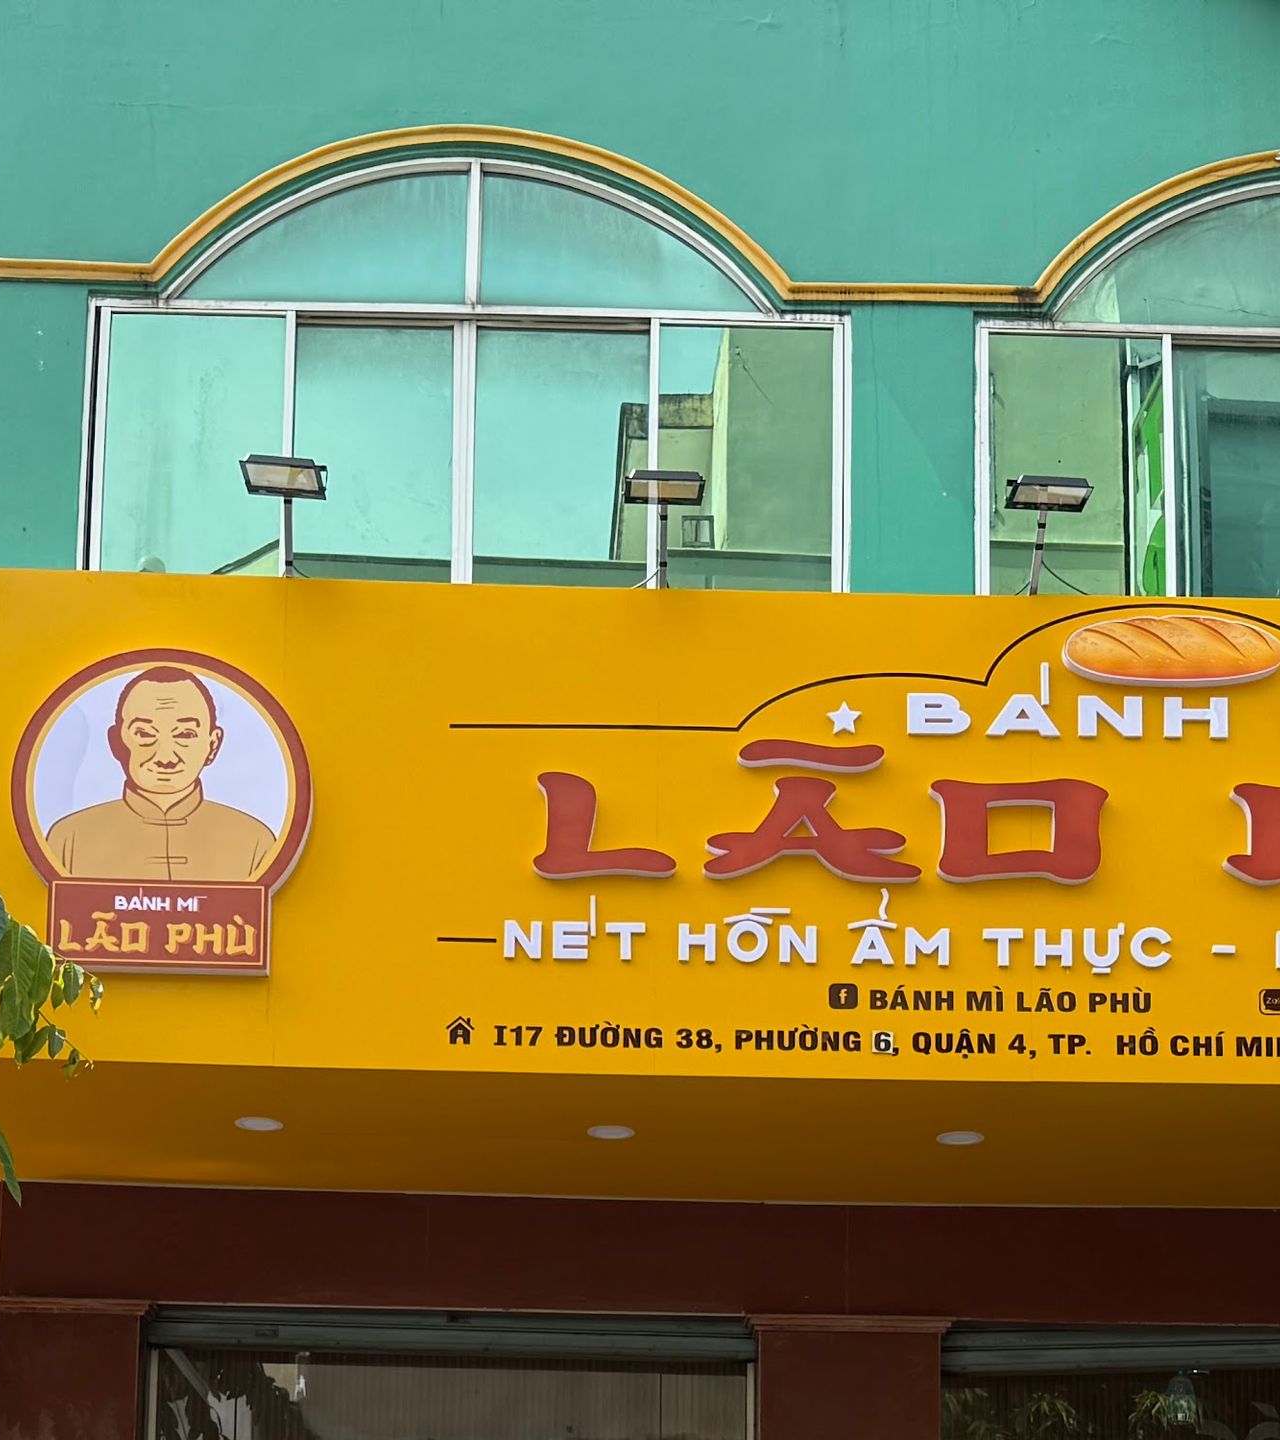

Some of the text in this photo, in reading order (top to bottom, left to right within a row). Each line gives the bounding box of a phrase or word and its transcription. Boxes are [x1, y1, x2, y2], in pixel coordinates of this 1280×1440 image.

[906, 662, 1229, 740] BÁNH
[532, 739, 1110, 884] LÃO
[58, 912, 256, 956] LÃO PHÙ
[983, 922, 1173, 975] THỰC
[869, 985, 954, 1012] BÁNH
[966, 986, 1004, 1012] MÌ
[1016, 988, 1077, 1013] LÃO
[1089, 987, 1152, 1014] PHÙ
[555, 1021, 664, 1048] ĐƯỜNG
[676, 1028, 723, 1053] 38,
[735, 1024, 861, 1051] PHƯỜNG
[872, 1030, 900, 1056] 6,
[912, 1029, 996, 1058] QUẬN
[1008, 1034, 1037, 1059] 4,
[1048, 1034, 1092, 1055] TP.
[1116, 1026, 1159, 1055] HỒ
[1170, 1030, 1224, 1057] CHÍ
